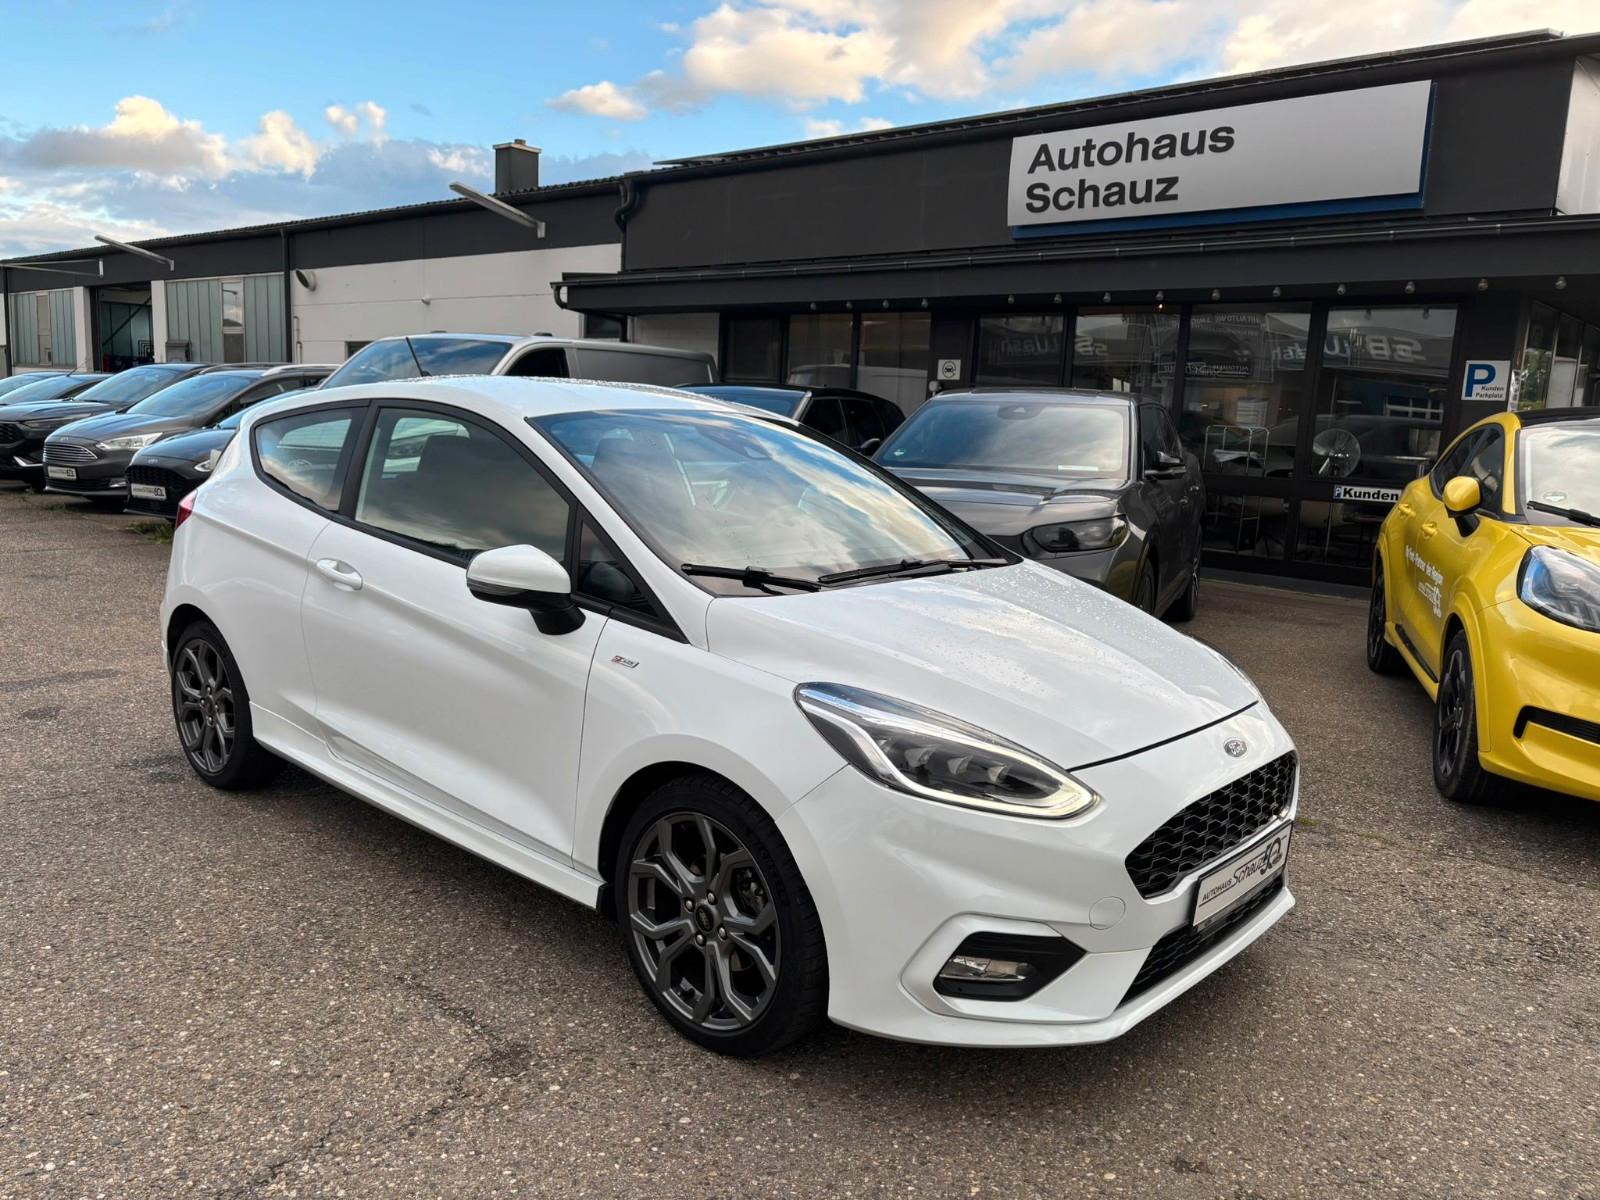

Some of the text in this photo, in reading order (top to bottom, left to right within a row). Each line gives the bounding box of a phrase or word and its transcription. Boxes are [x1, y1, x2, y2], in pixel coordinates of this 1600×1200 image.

[1027, 125, 1235, 174] Autohaus
[1025, 176, 1179, 213] Schauz
[1465, 363, 1496, 397] P
[1343, 487, 1399, 501] Kunden
[1201, 878, 1233, 902] AUTOHAUS
[1234, 853, 1266, 883] Schauz
